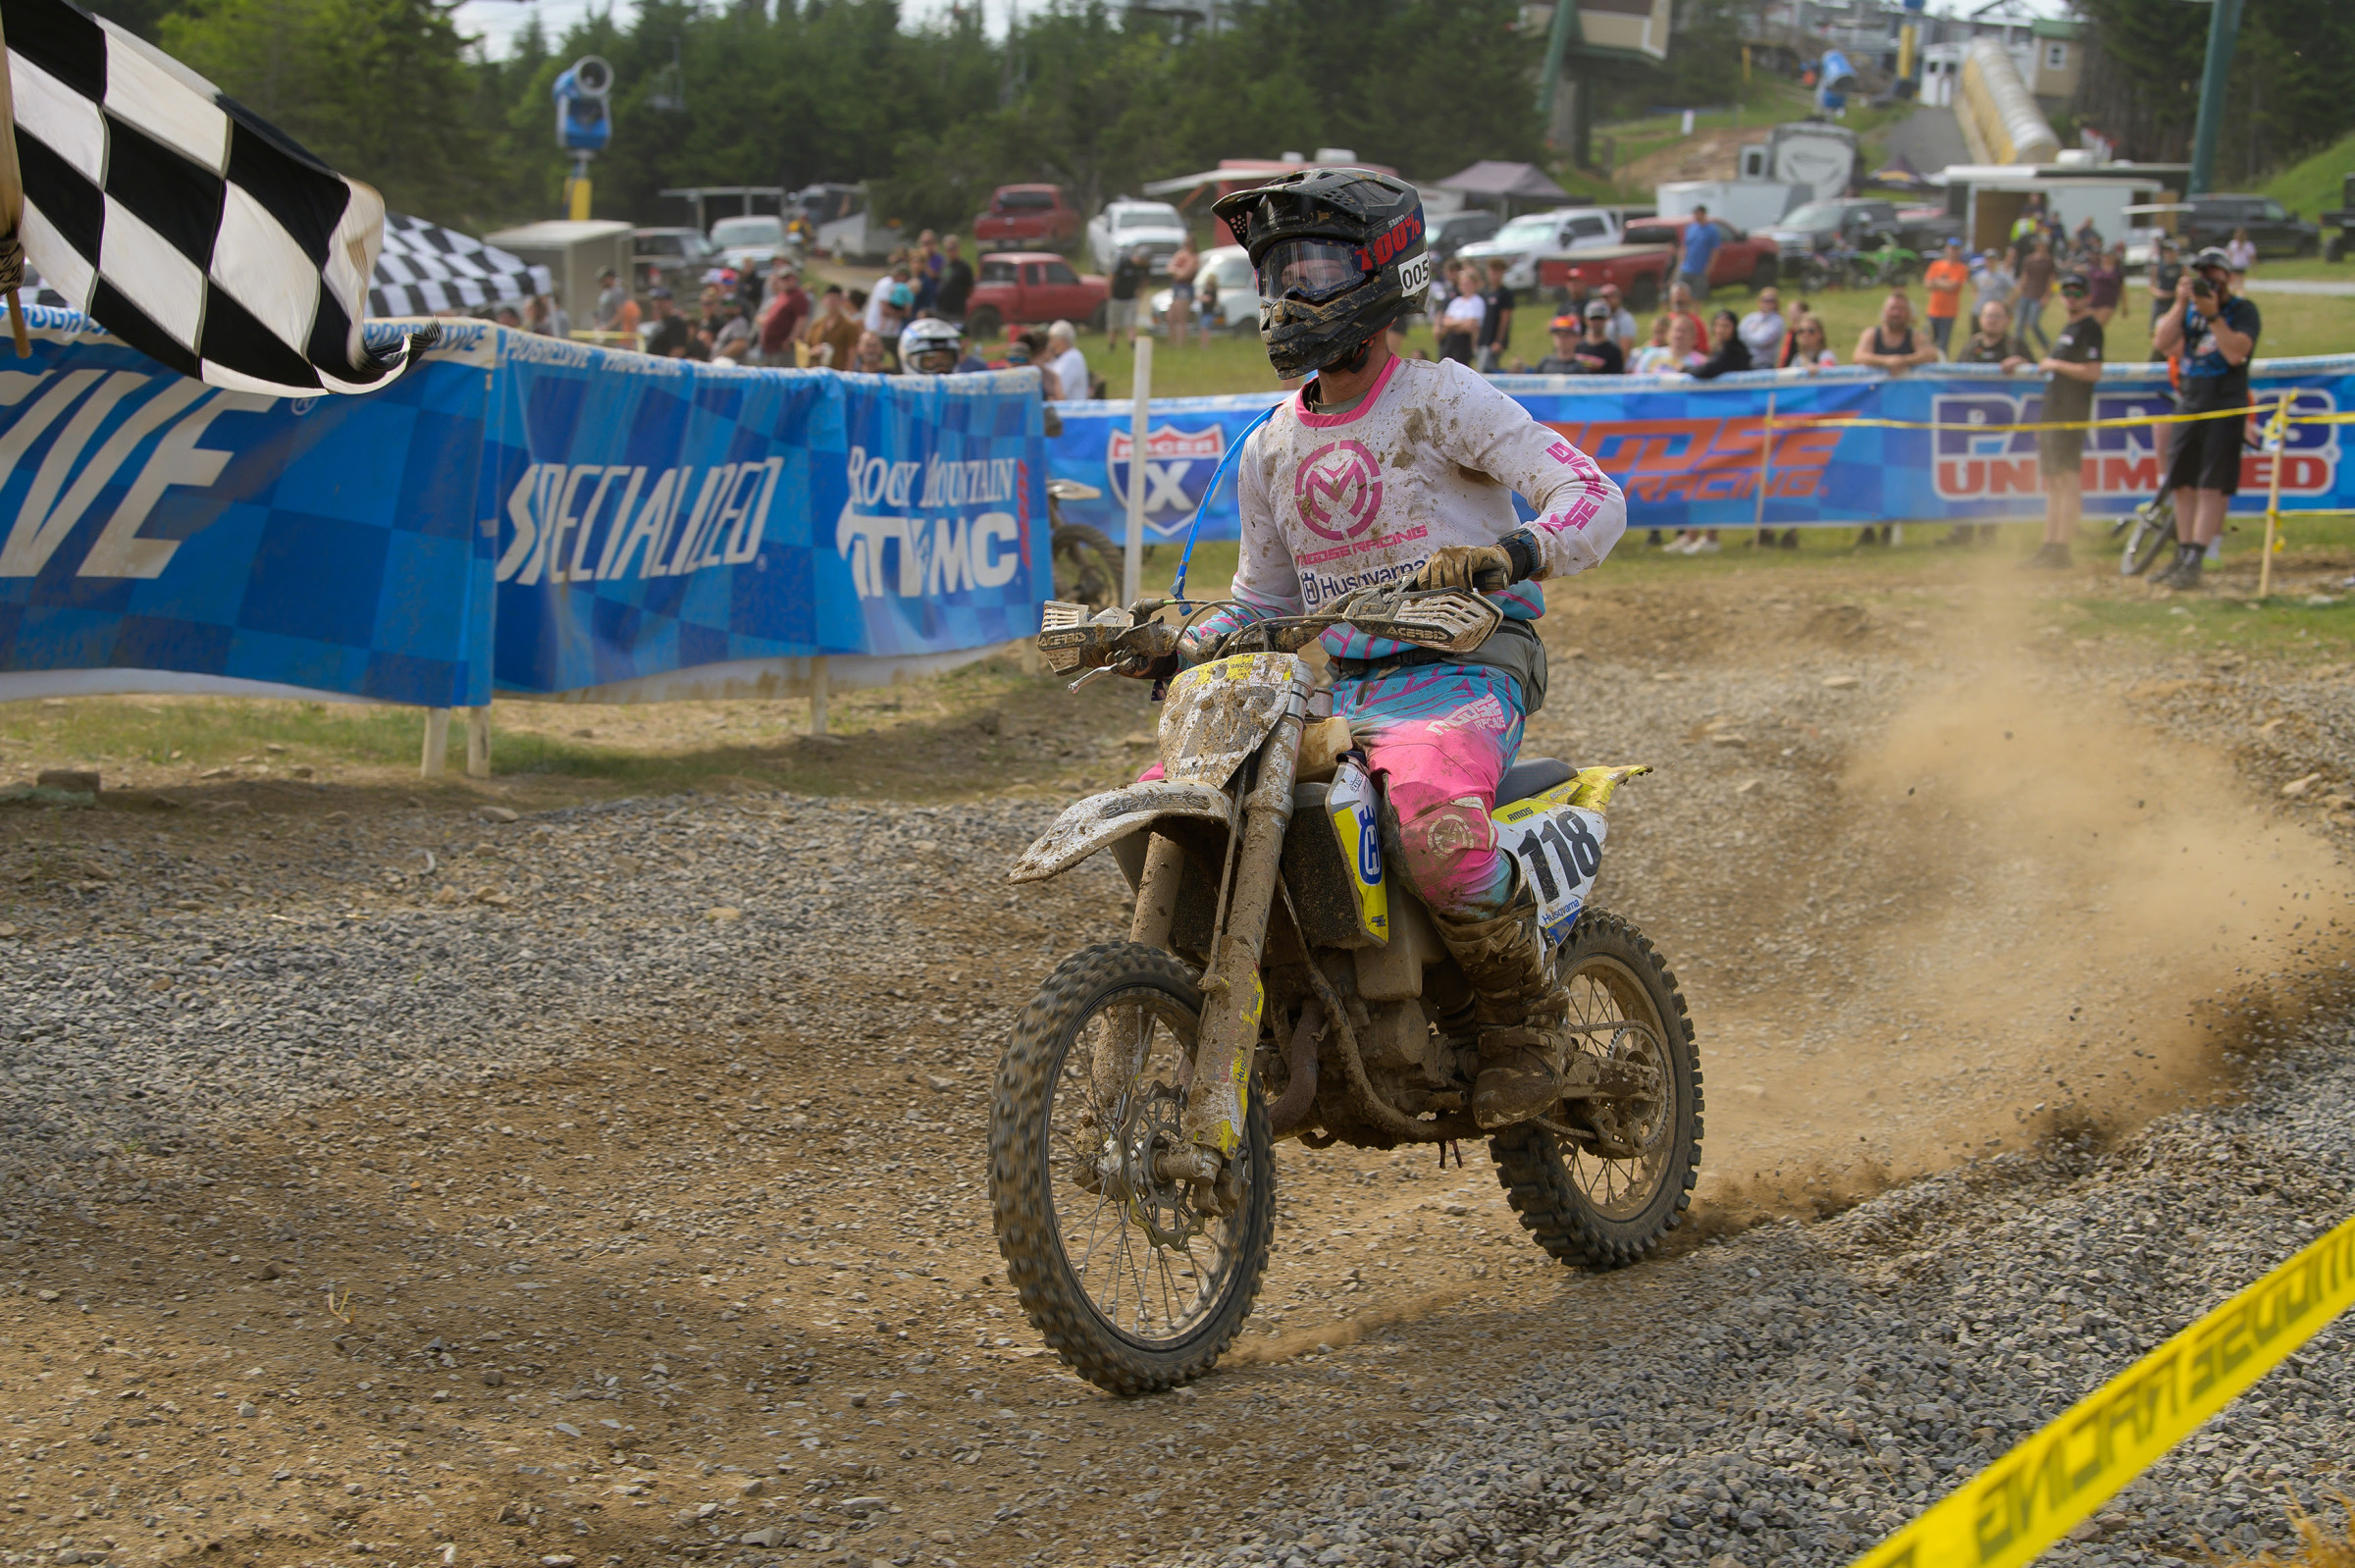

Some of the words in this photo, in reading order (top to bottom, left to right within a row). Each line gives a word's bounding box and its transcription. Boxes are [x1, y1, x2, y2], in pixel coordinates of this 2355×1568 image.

[1402, 258, 1429, 290] 005
[1143, 460, 1194, 513] X
[1624, 467, 1822, 503] RACING
[1351, 524, 1429, 554] RACING
[1507, 807, 1534, 822] AMOS
[1517, 810, 1602, 905] 118
[1542, 898, 1580, 924] Husqvarna
